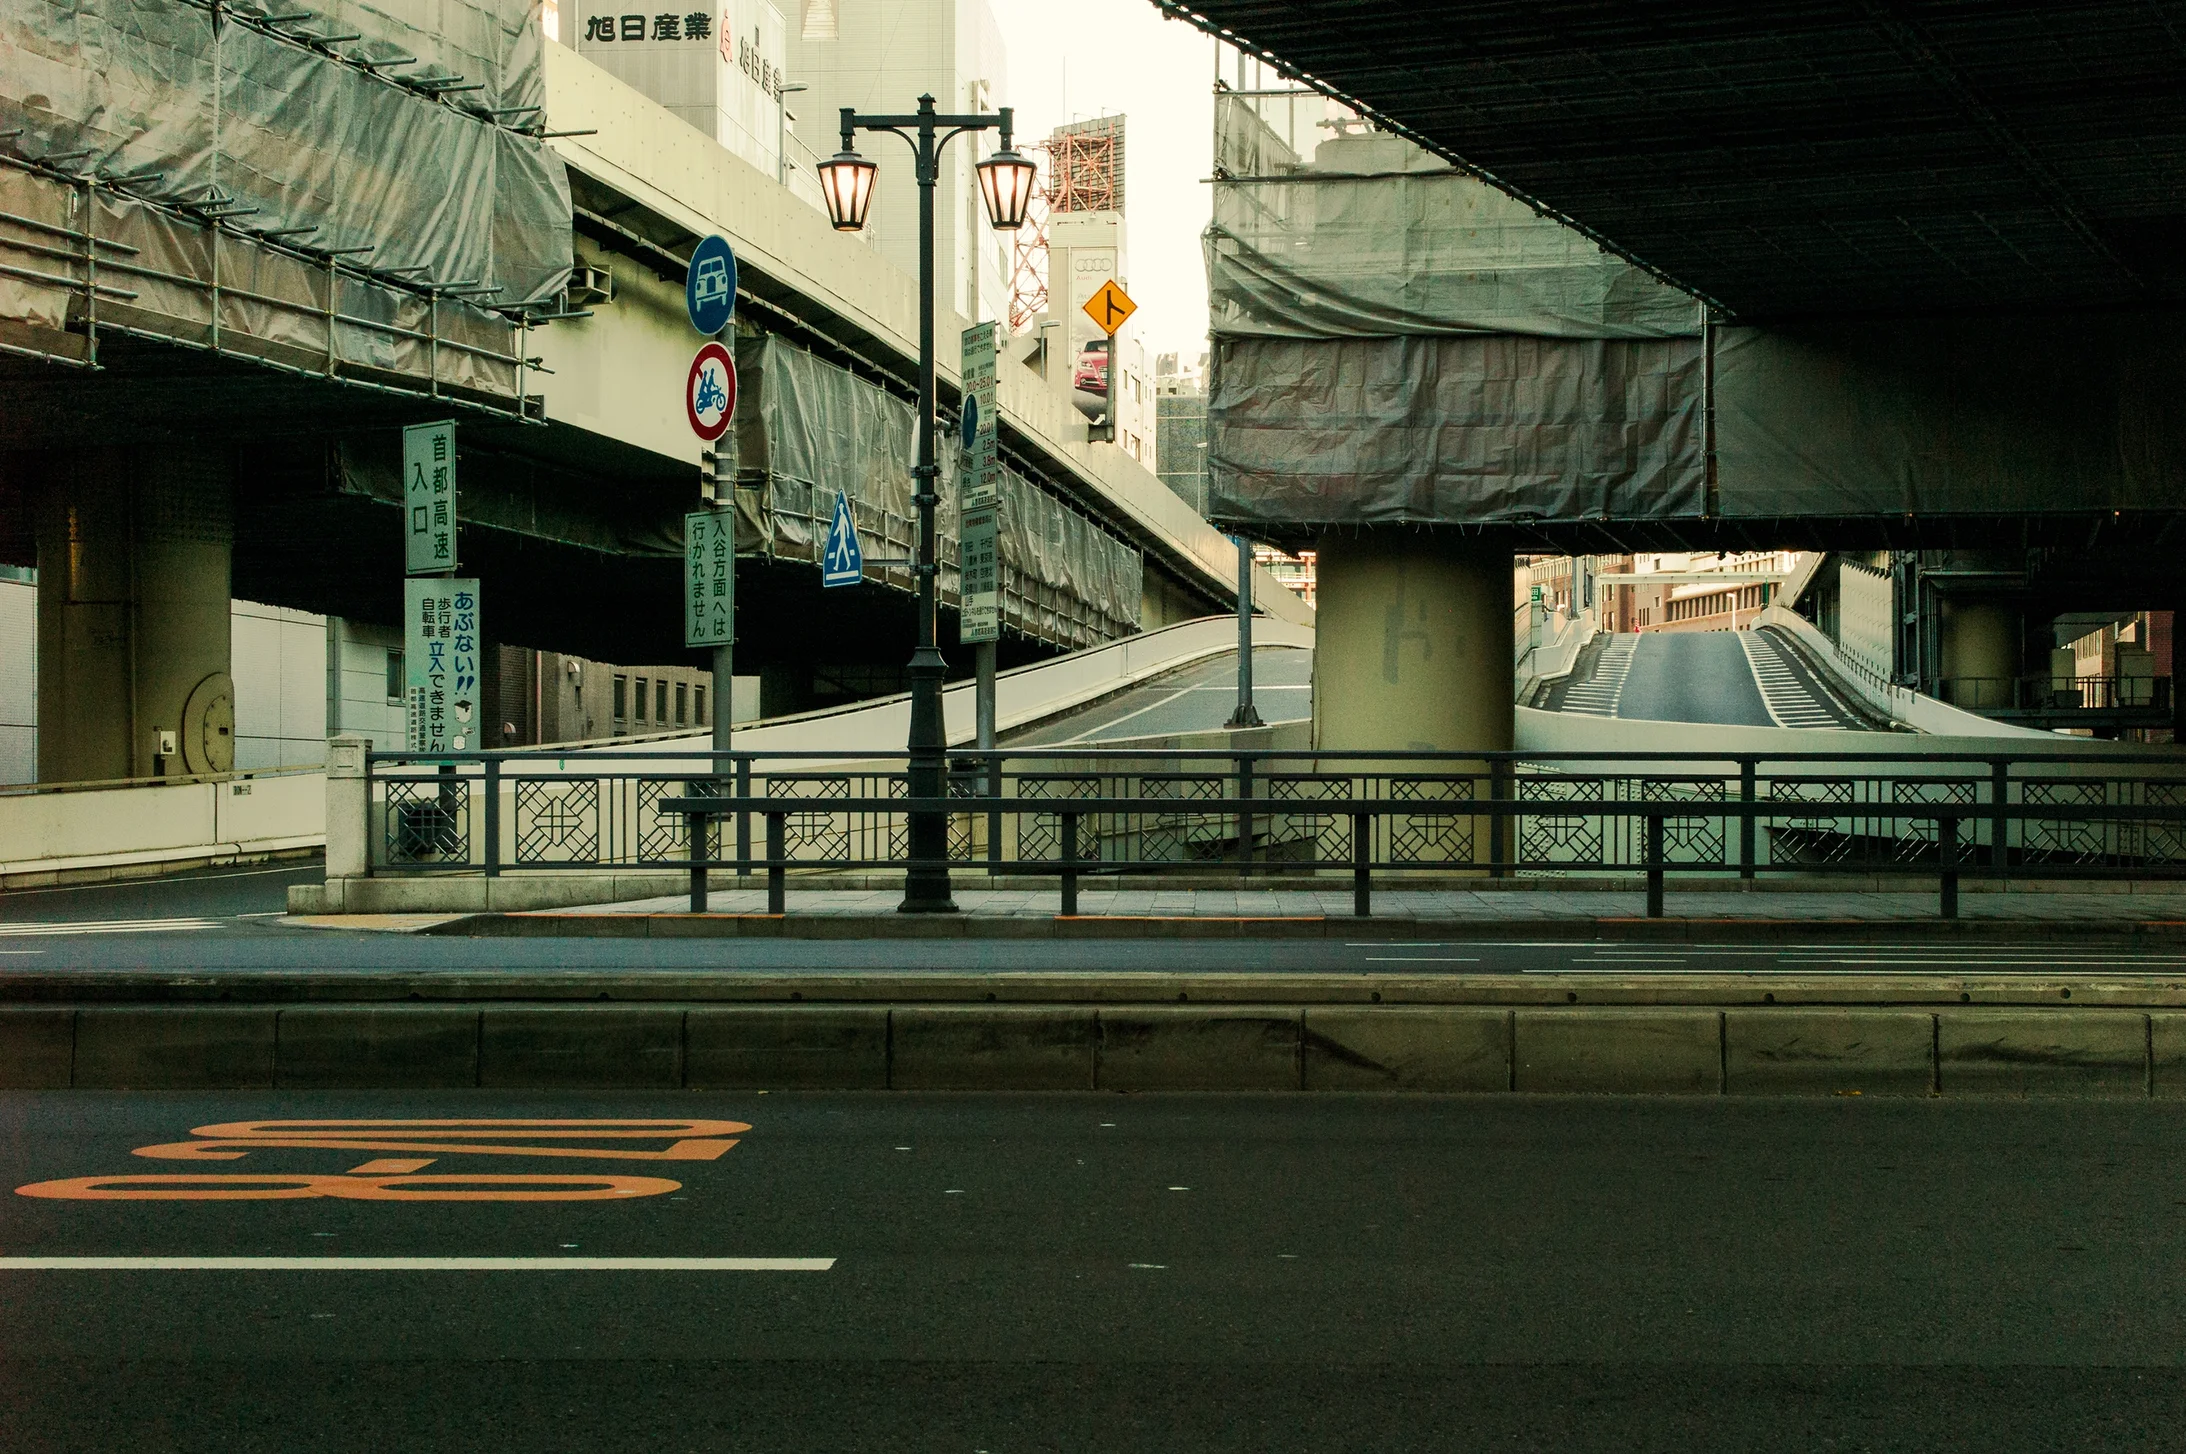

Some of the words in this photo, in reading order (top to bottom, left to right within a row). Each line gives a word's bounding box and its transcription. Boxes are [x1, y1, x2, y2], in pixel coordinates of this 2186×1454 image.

[585, 12, 712, 42] 旭日産業
[411, 461, 428, 535] 入口
[432, 434, 449, 560] 首都高速
[421, 597, 435, 639] 自転車
[438, 597, 451, 639] 歩行者
[692, 521, 706, 637] 行かれません
[713, 519, 727, 636] 入谷方面へは
[428, 640, 446, 753] 立入できません
